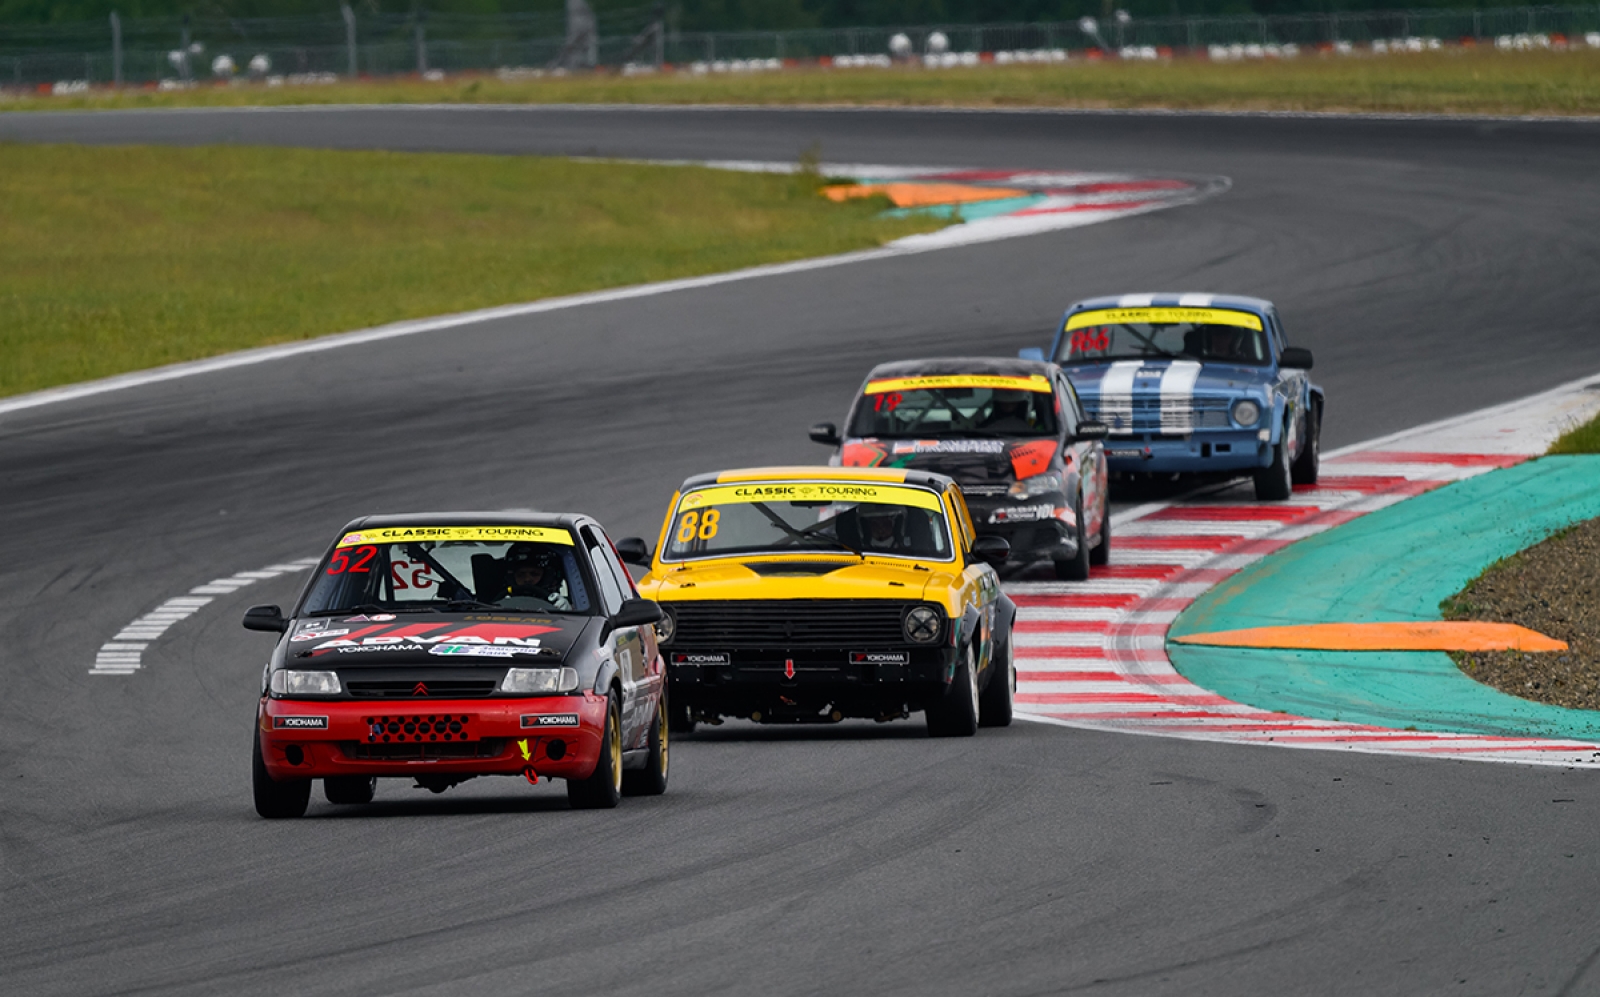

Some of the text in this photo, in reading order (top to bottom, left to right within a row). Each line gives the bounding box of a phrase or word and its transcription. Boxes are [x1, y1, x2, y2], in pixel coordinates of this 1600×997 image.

[1070, 328, 1110, 354] 966
[873, 393, 903, 412] 19
[735, 486, 878, 497] CLASSIC TOURING
[677, 509, 721, 543] 88
[382, 527, 544, 537] CLASSIC TOURING
[326, 545, 378, 575] 52
[311, 635, 541, 650] ADVAN
[337, 643, 424, 654] YOKOHAMA
[866, 654, 905, 662] YOKOHAMA
[283, 718, 324, 727] YOKOHAMA
[537, 716, 577, 725] YOKOHAMA
